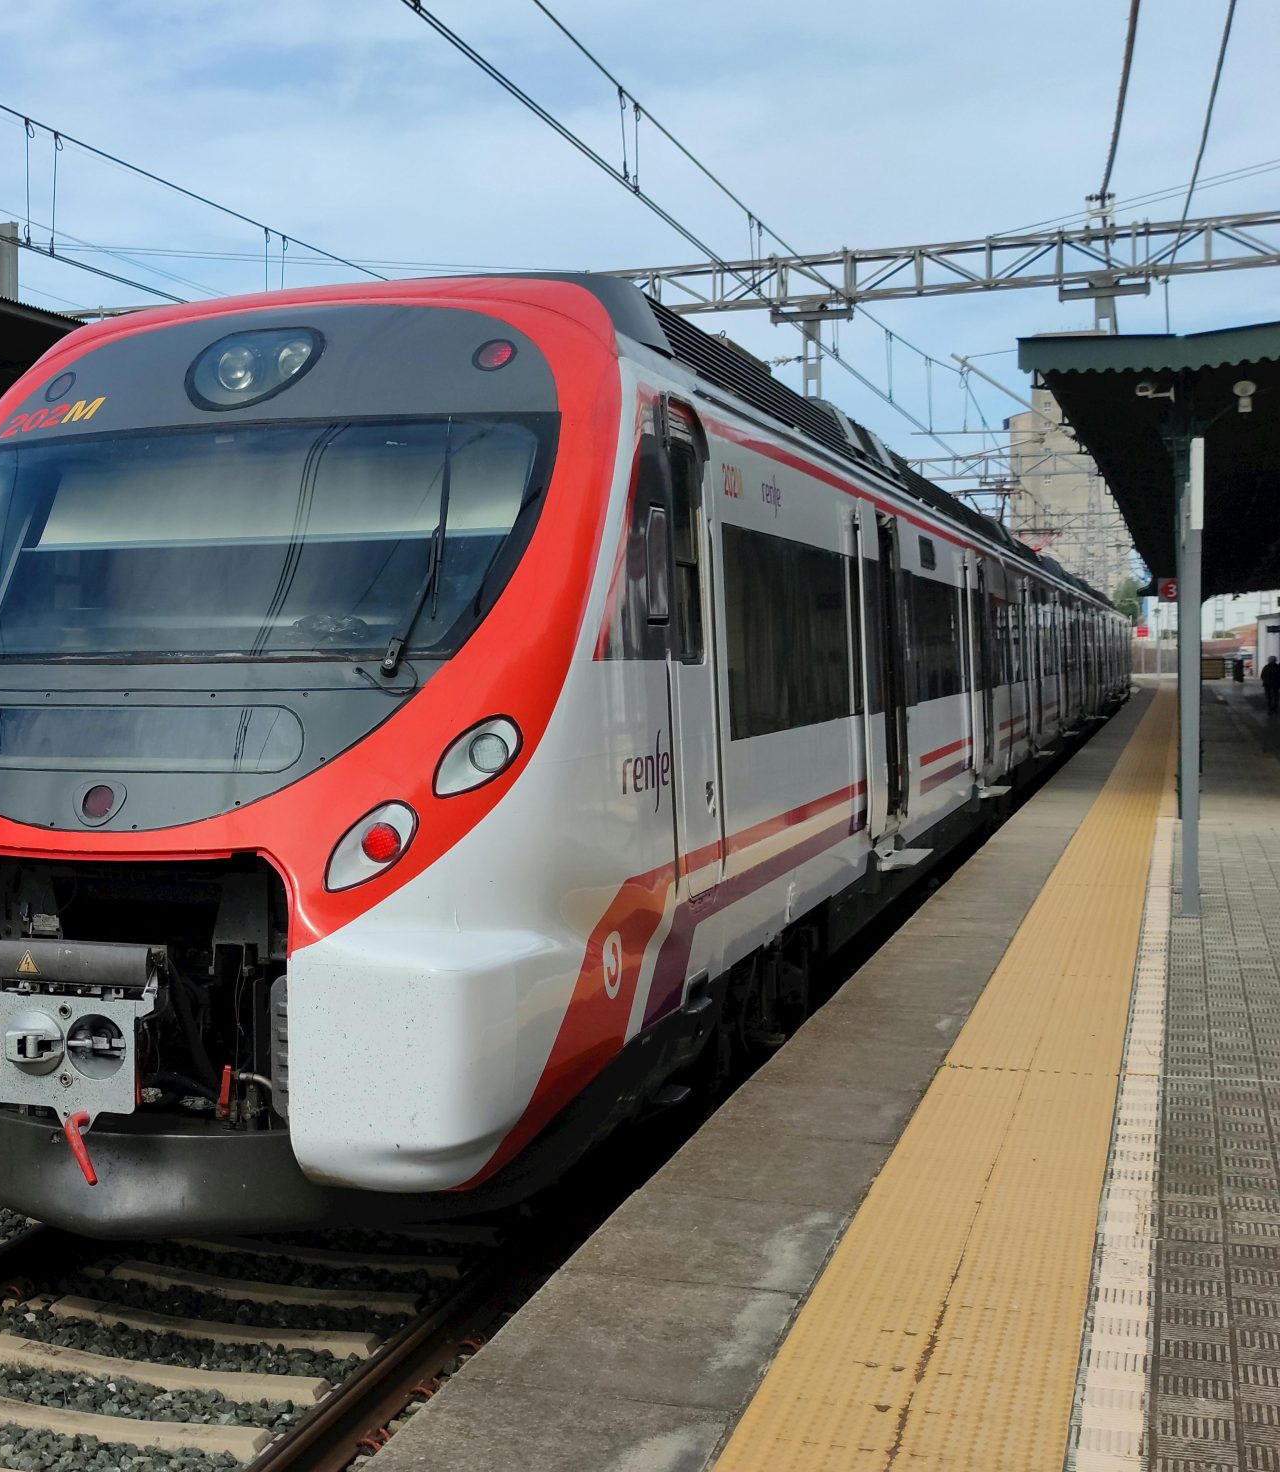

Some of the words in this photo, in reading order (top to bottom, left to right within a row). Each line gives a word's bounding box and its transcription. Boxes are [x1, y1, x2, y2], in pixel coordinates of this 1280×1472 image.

[0, 396, 107, 439] 202M
[761, 473, 782, 519] renfe
[1167, 584, 1177, 598] 3
[622, 729, 670, 814] renfe
